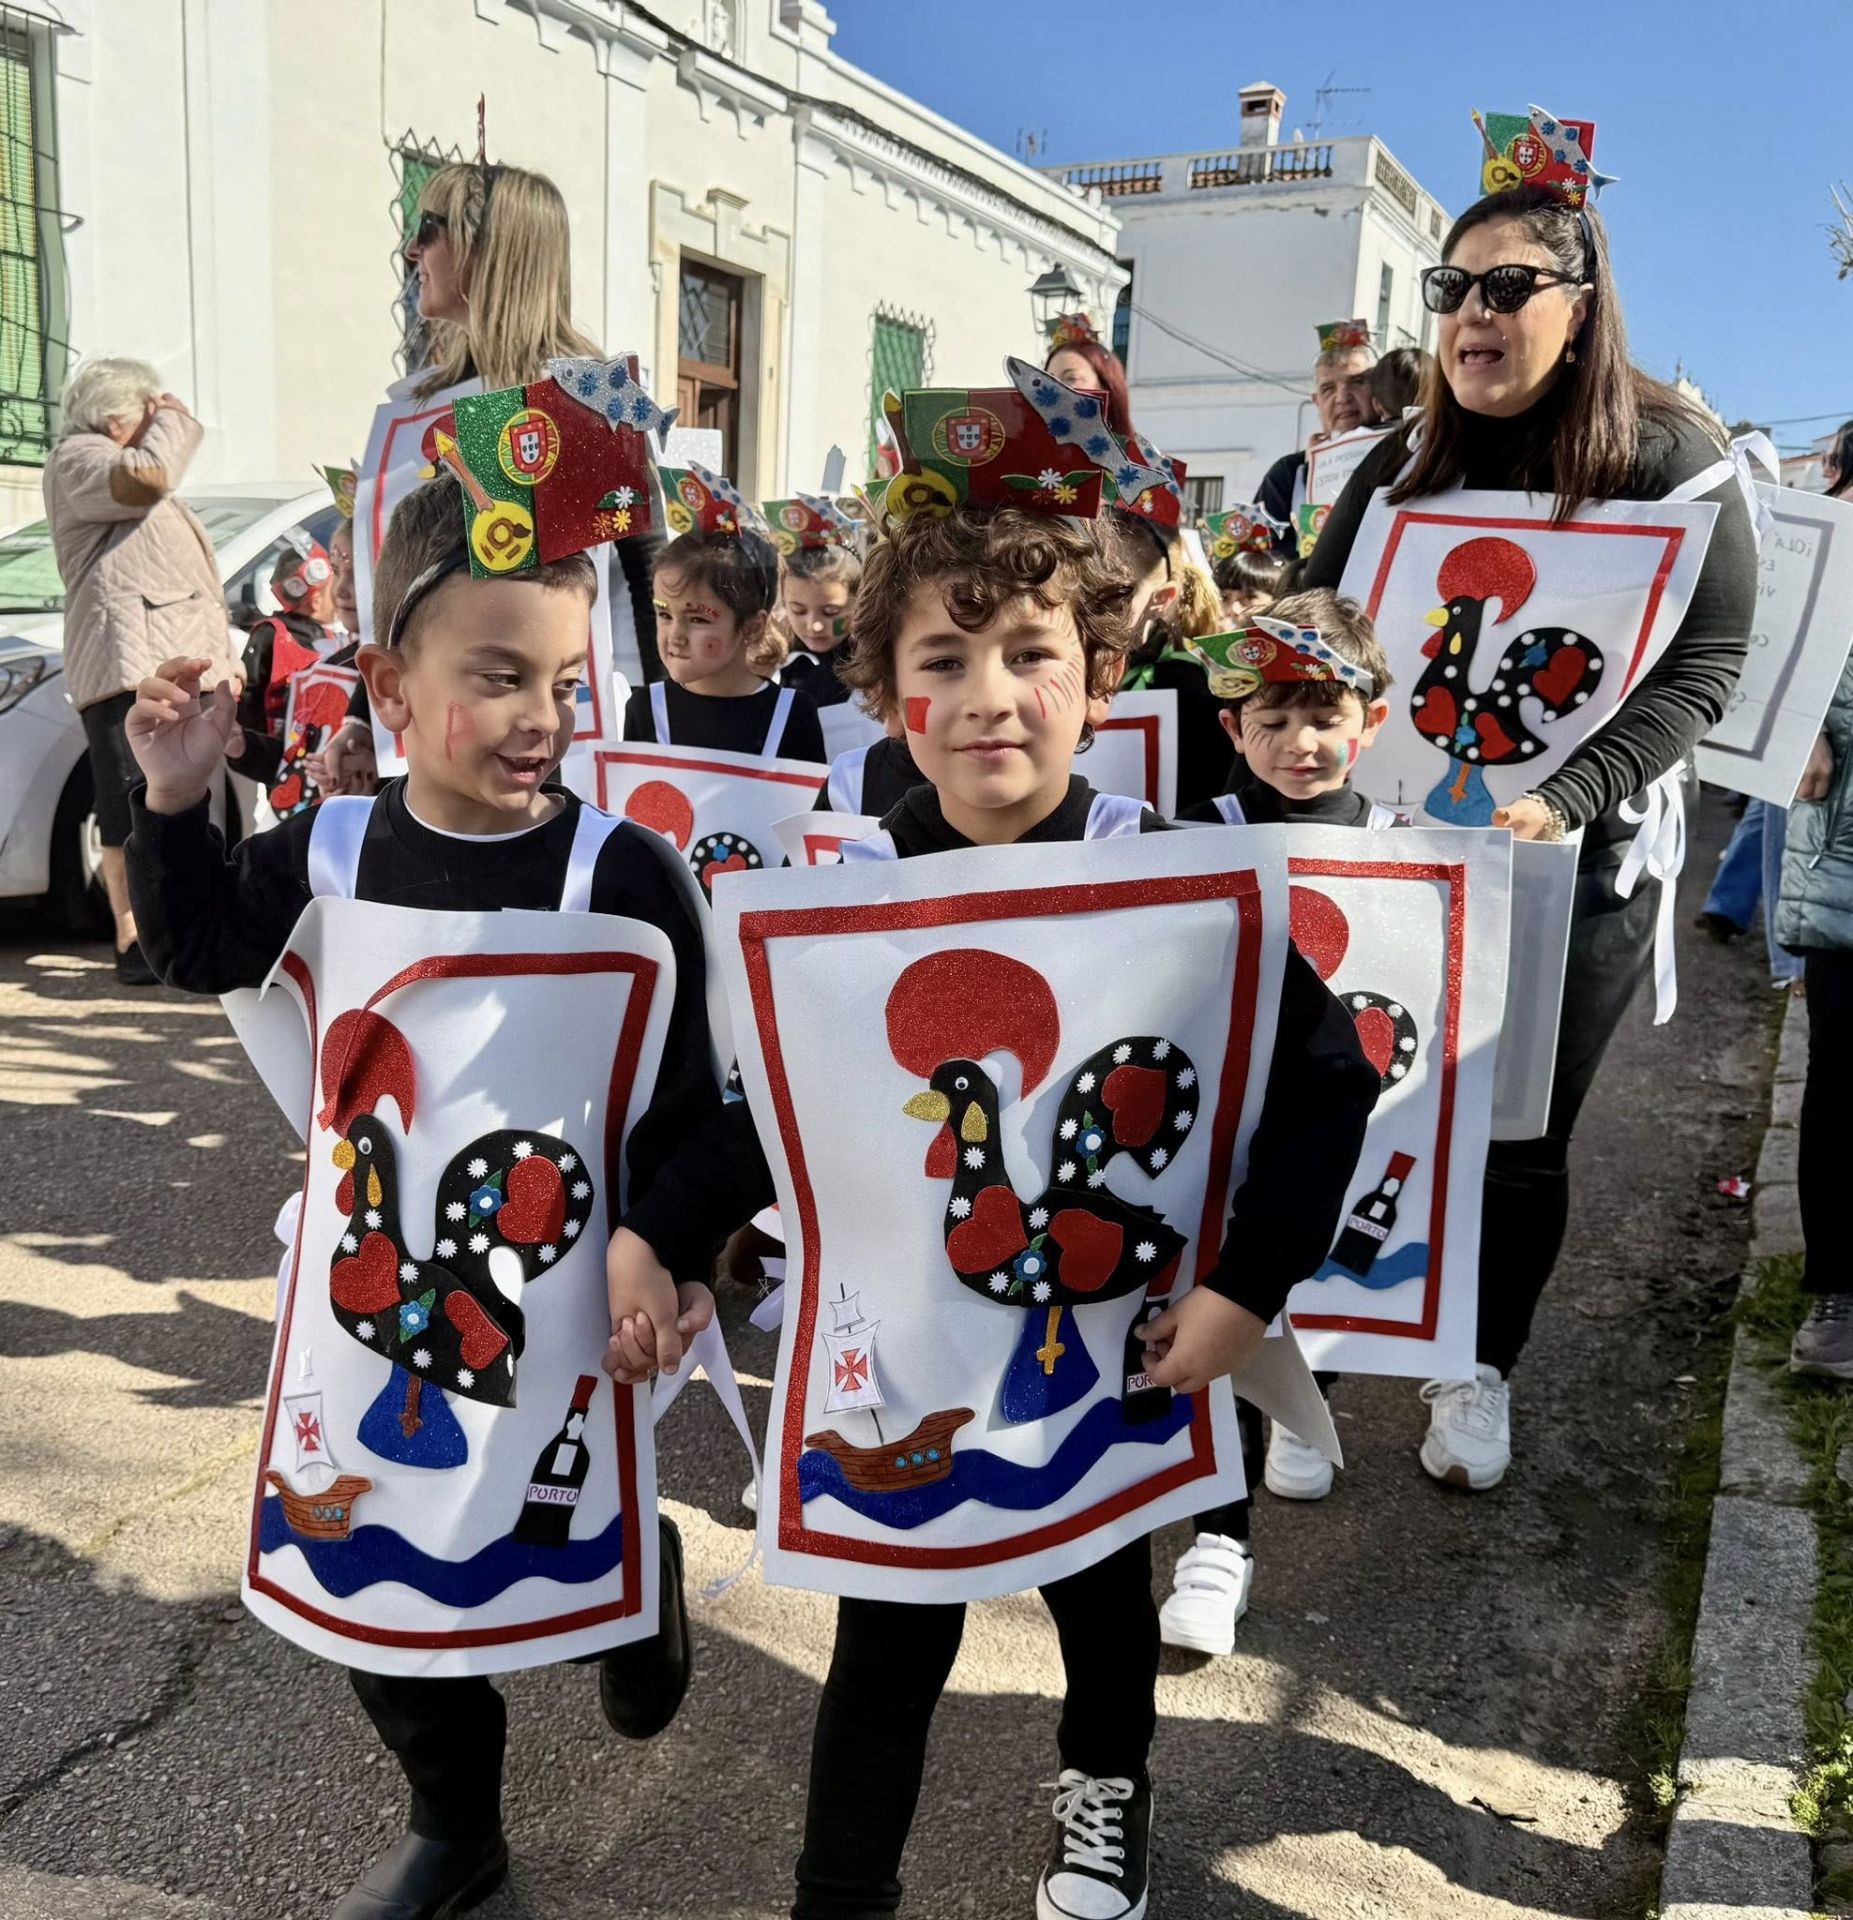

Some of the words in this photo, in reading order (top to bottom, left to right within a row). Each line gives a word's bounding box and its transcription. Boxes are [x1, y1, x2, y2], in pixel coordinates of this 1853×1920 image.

[1350, 1216, 1387, 1240] PORTO
[1128, 1374, 1154, 1391] POR
[529, 1485, 577, 1503] PORTO
